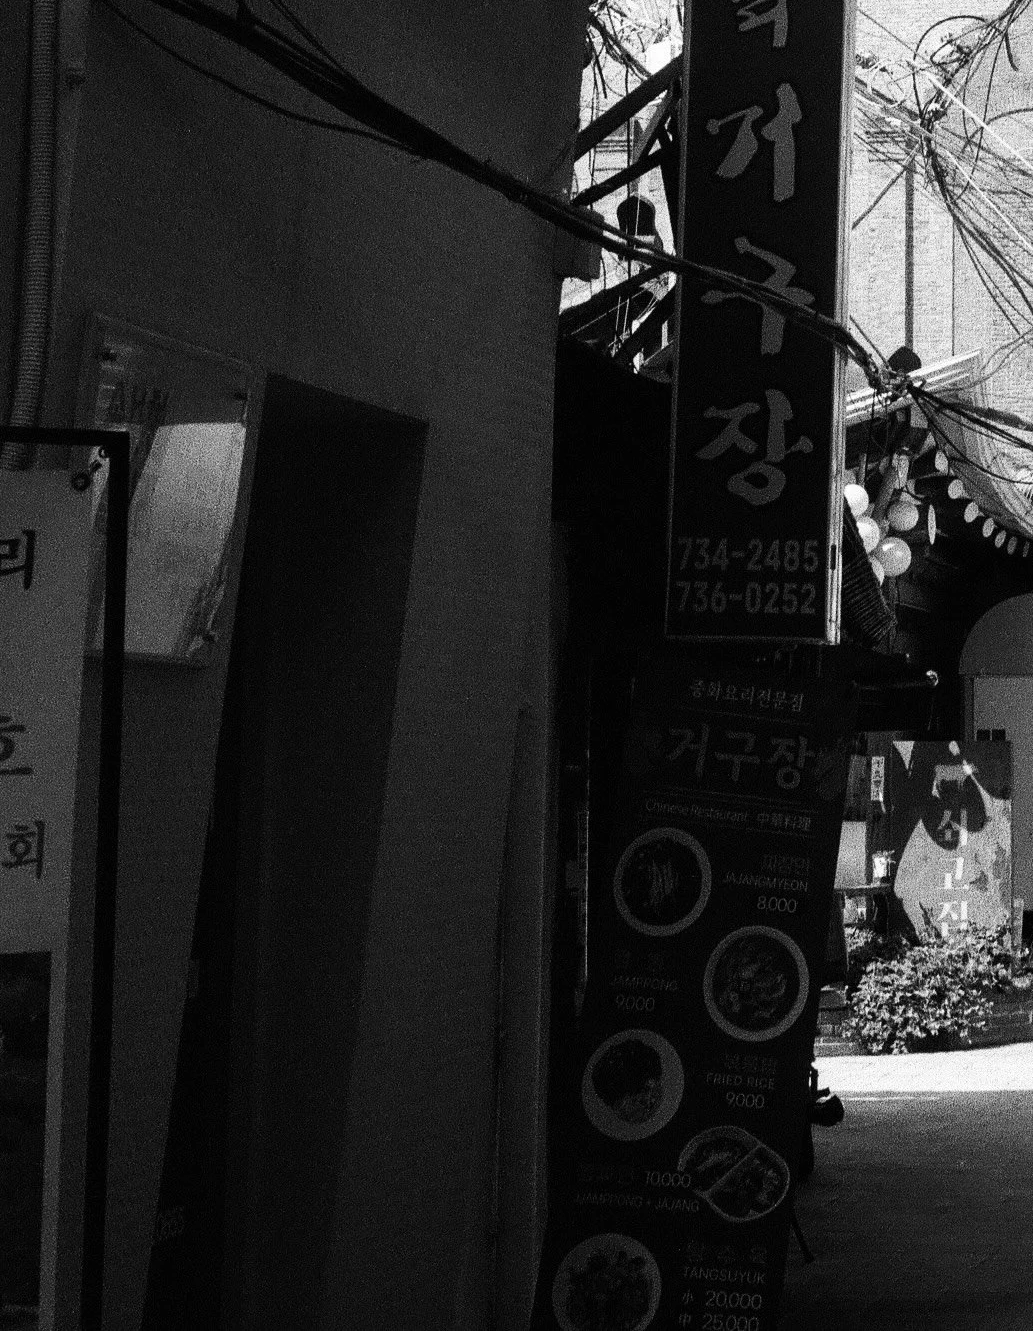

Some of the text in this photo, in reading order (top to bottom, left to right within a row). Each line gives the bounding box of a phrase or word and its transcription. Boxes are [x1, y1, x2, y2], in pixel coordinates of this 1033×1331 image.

[696, 82, 816, 506] 거구장
[676, 538, 820, 573] 734-2485
[675, 581, 818, 615] 736-0252
[664, 722, 817, 791] 거구장
[682, 1265, 767, 1286] TANGSUYUK
